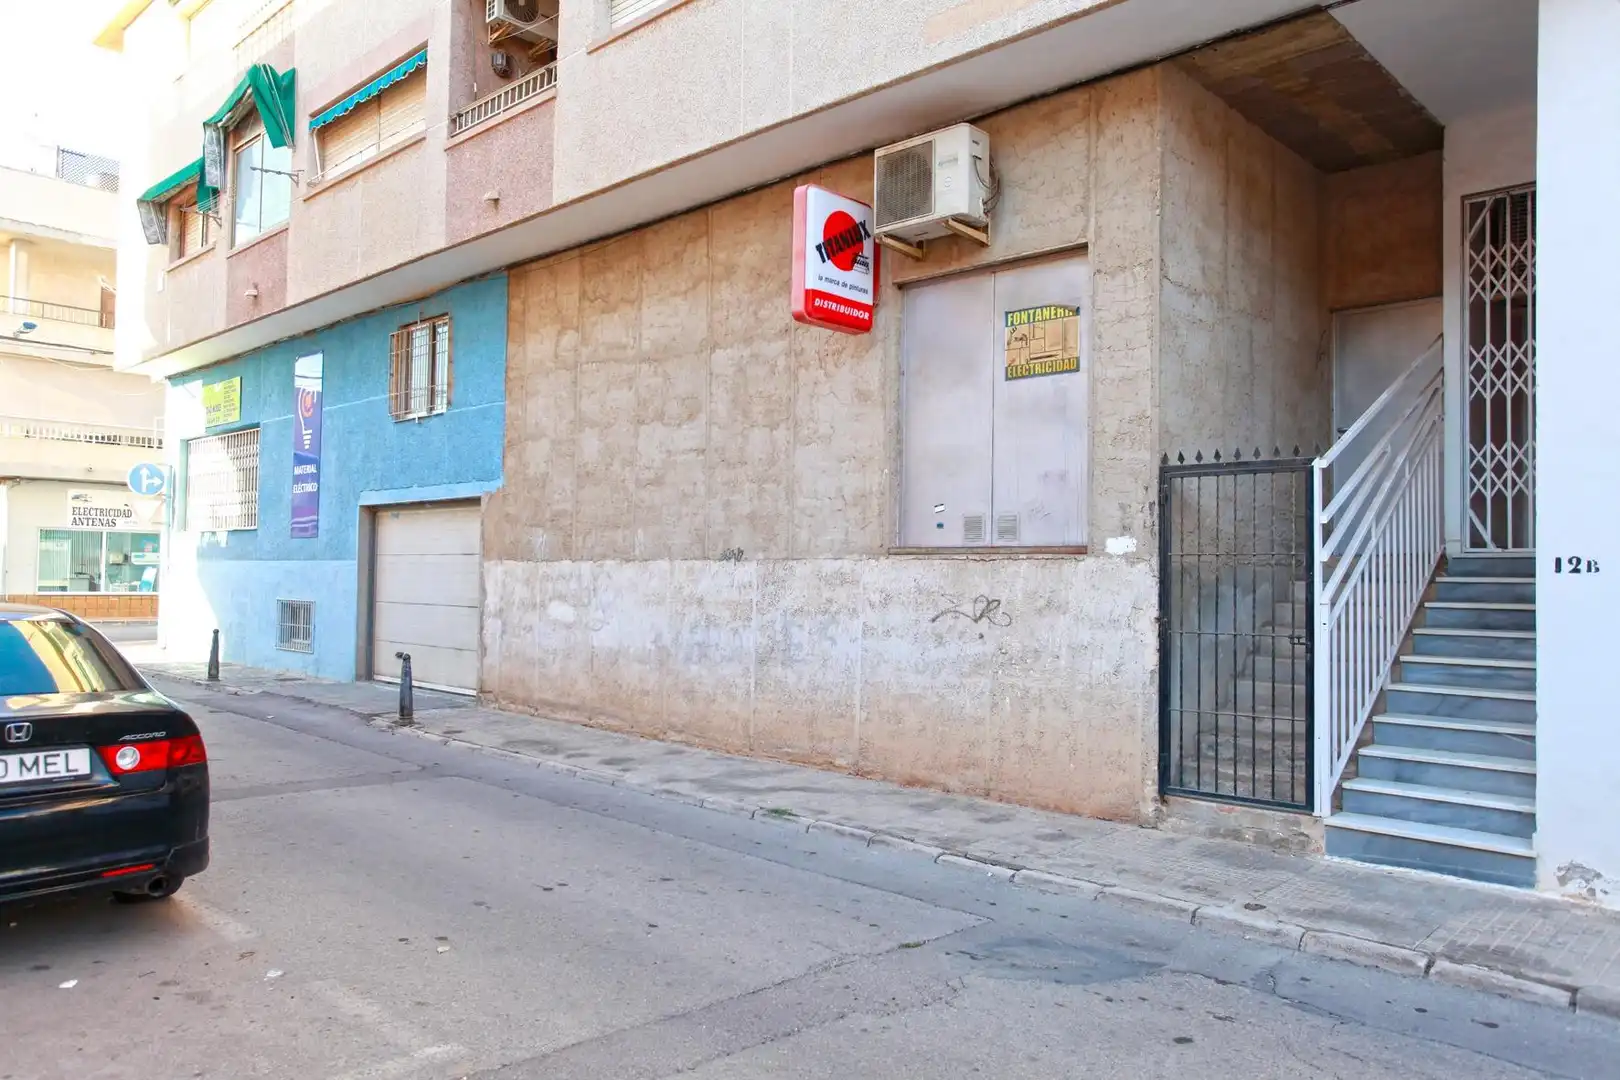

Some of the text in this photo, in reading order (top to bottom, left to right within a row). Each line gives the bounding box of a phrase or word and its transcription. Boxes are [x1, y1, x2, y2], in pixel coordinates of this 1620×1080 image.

[815, 219, 871, 264] TITANLUX
[825, 277, 840, 286] marca
[849, 284, 868, 295] pinturas
[814, 298, 870, 320] DISTRIBUIDOR
[1007, 357, 1077, 378] ELECTRICIDAD
[294, 464, 317, 475] MATERIAL
[71, 506, 133, 519] ELECTRICIDAD
[71, 517, 117, 528] ANTENAS
[118, 731, 166, 741] ACCORD
[19, 753, 79, 777] MEL
